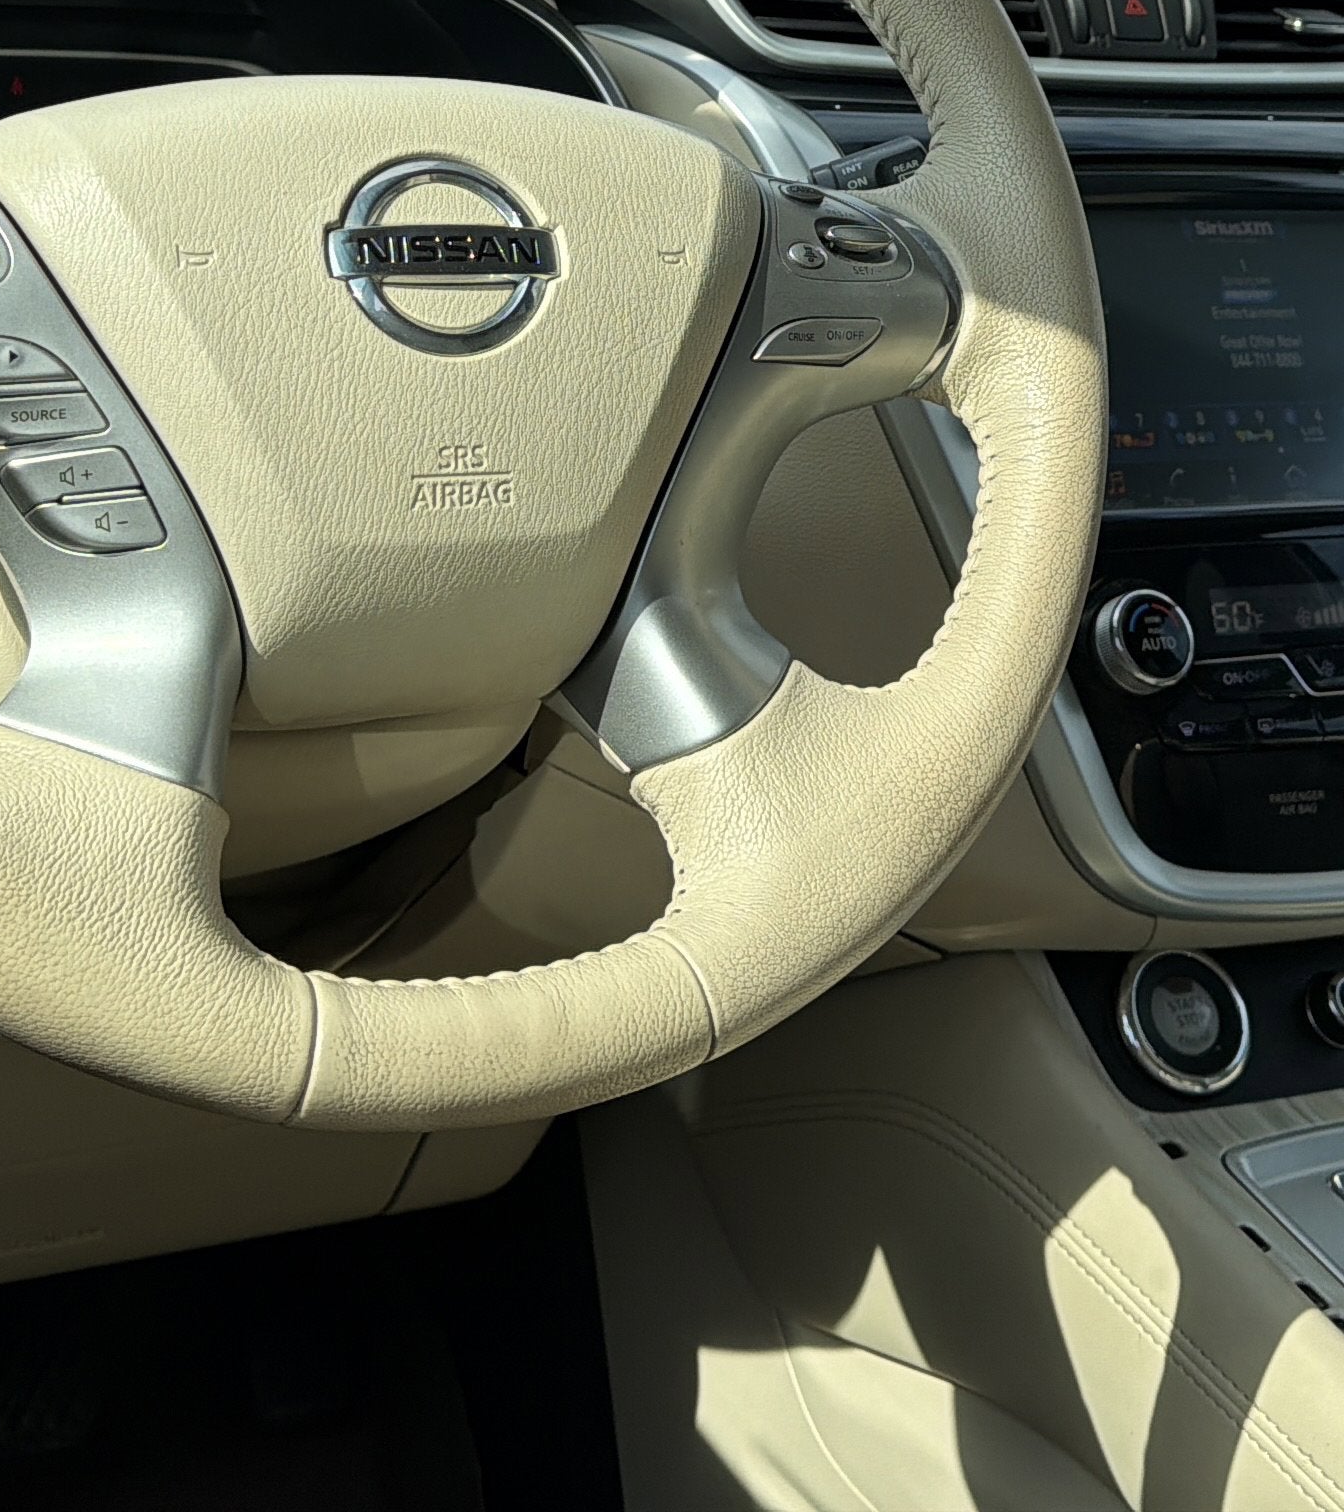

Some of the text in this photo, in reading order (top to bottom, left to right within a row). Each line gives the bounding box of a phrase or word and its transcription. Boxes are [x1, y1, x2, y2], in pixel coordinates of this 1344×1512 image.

[840, 159, 919, 176] INT REAR
[847, 175, 869, 190] ON
[1194, 219, 1274, 236] SiriusXM
[355, 233, 541, 266] NISSAN
[788, 330, 865, 343] CRUISE ON/OFF
[10, 407, 67, 424] SOURCE
[436, 444, 487, 470] SRS
[411, 475, 516, 510] AIRBAG
[1141, 635, 1177, 652] AUTO
